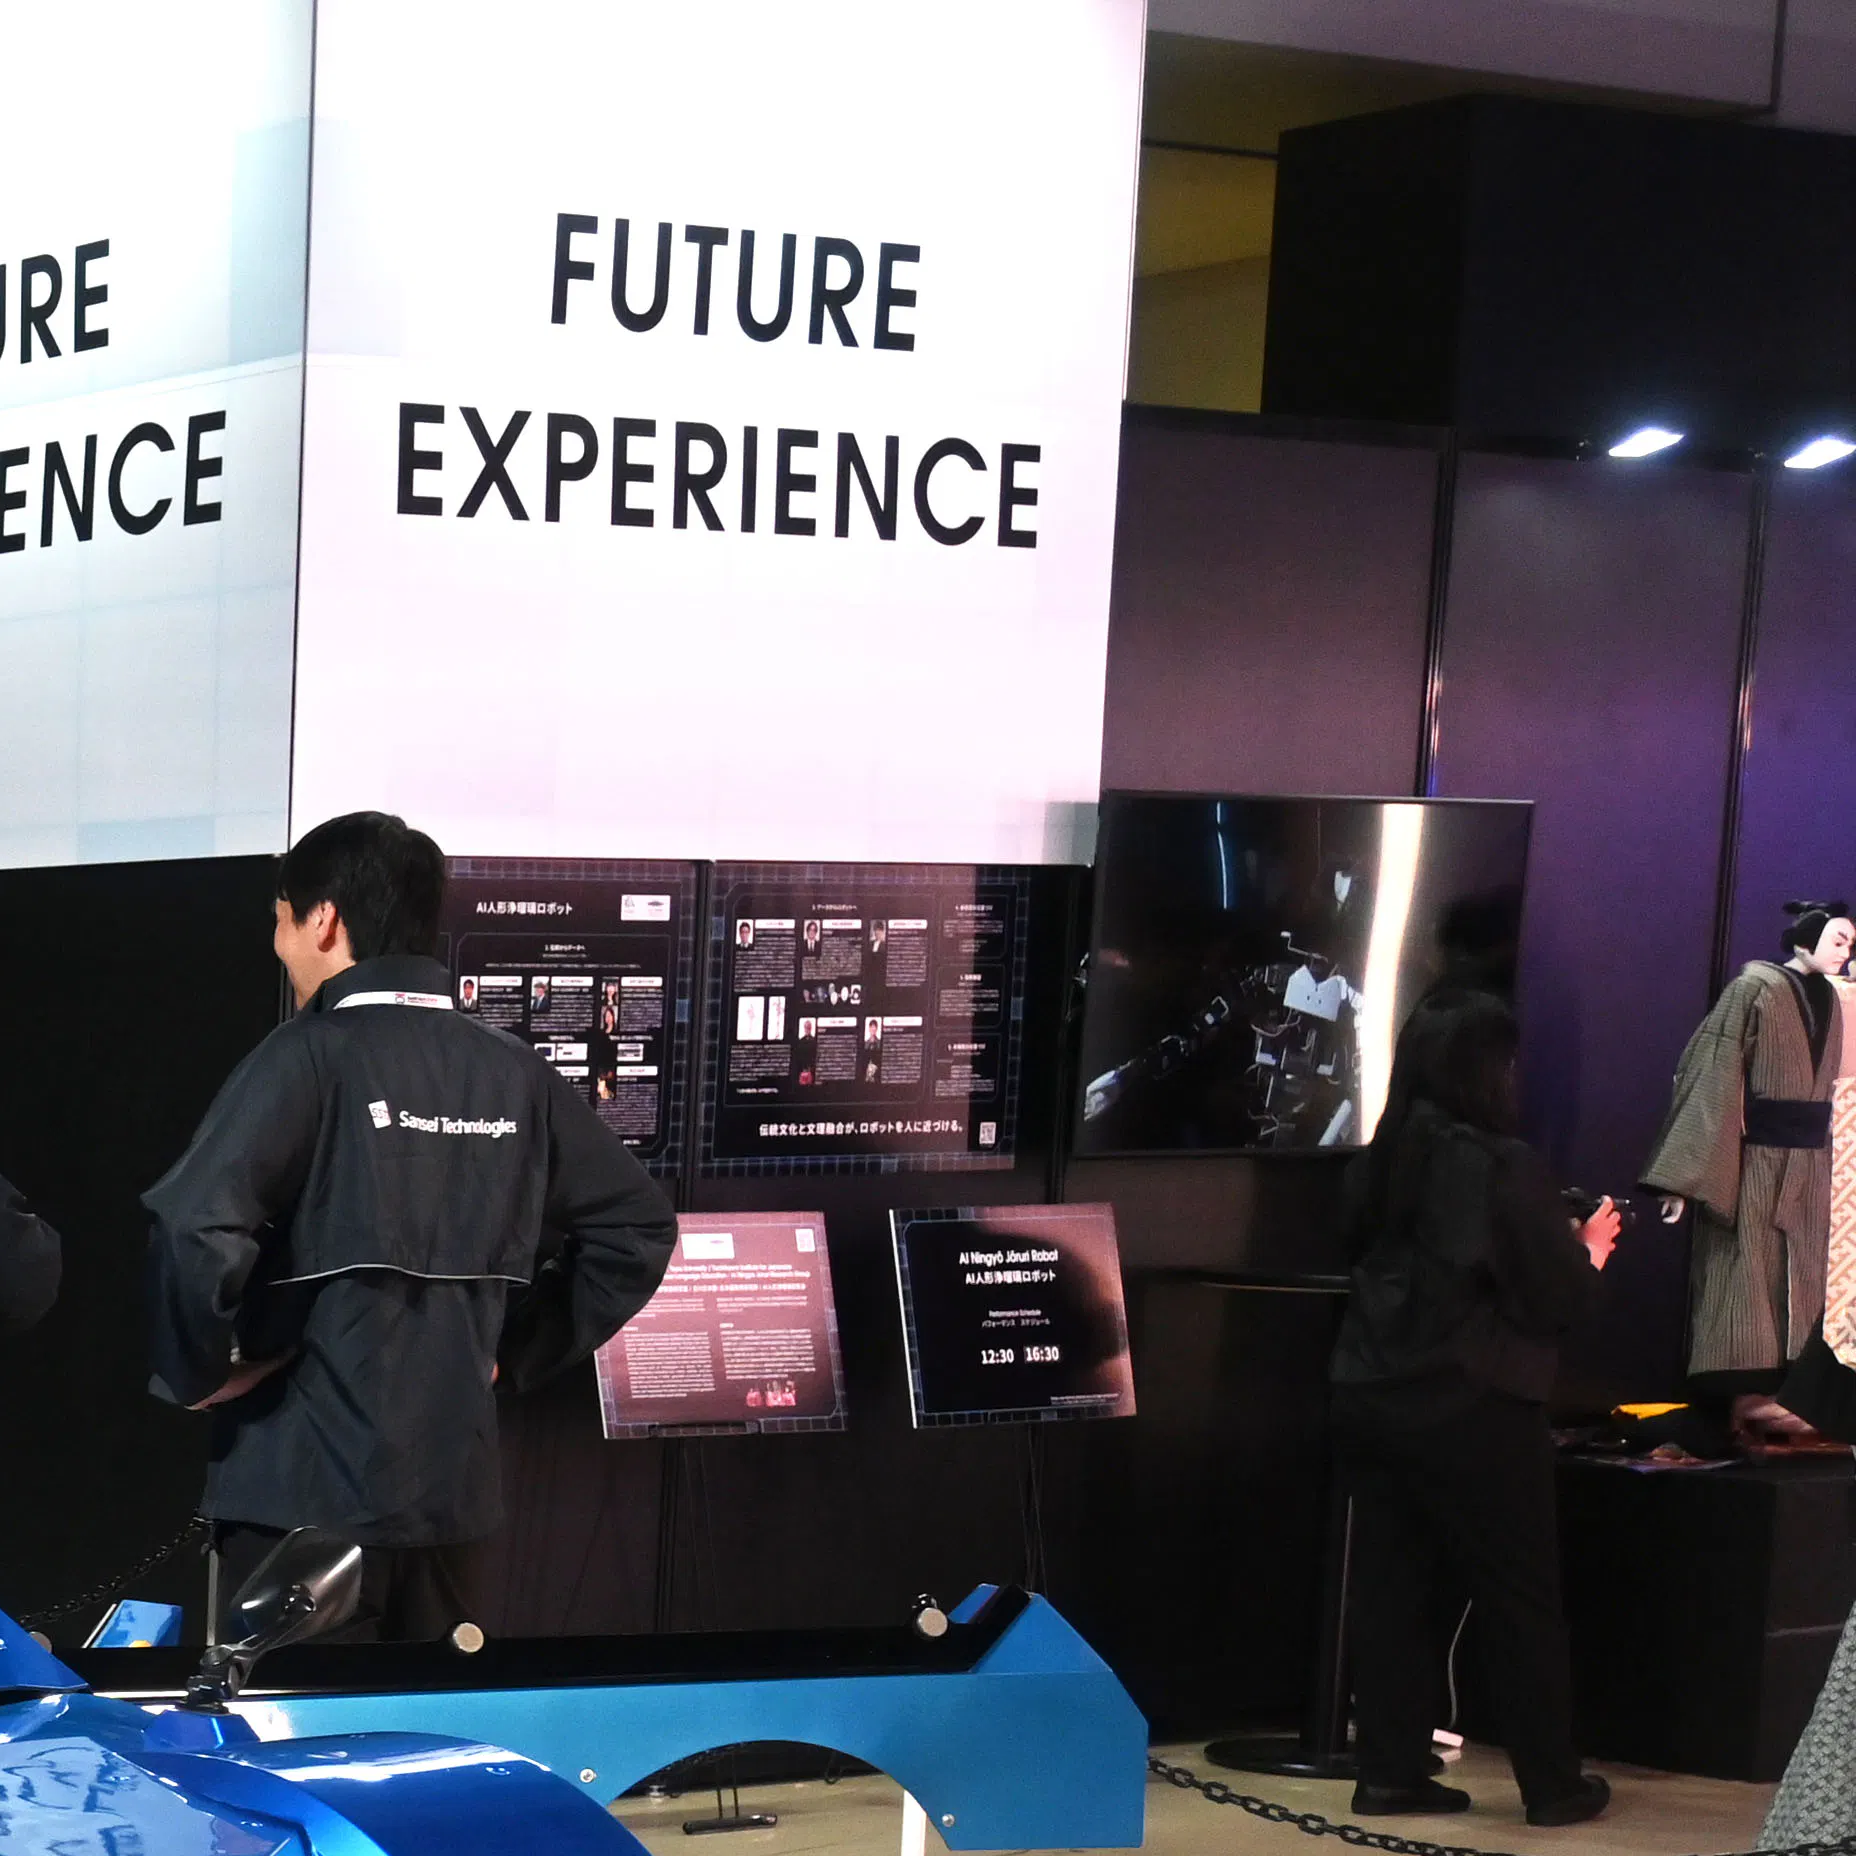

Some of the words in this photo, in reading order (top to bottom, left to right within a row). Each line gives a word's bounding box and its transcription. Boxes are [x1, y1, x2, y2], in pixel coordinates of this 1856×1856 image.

[550, 212, 922, 352] FUTURE
[396, 402, 1042, 549] EXPERIENCE
[399, 1110, 439, 1133] Sansei
[440, 1116, 517, 1138] Technologies
[1031, 1249, 1058, 1262] Robot
[981, 1348, 1015, 1365] 12:30
[1025, 1346, 1060, 1363] 16:30
